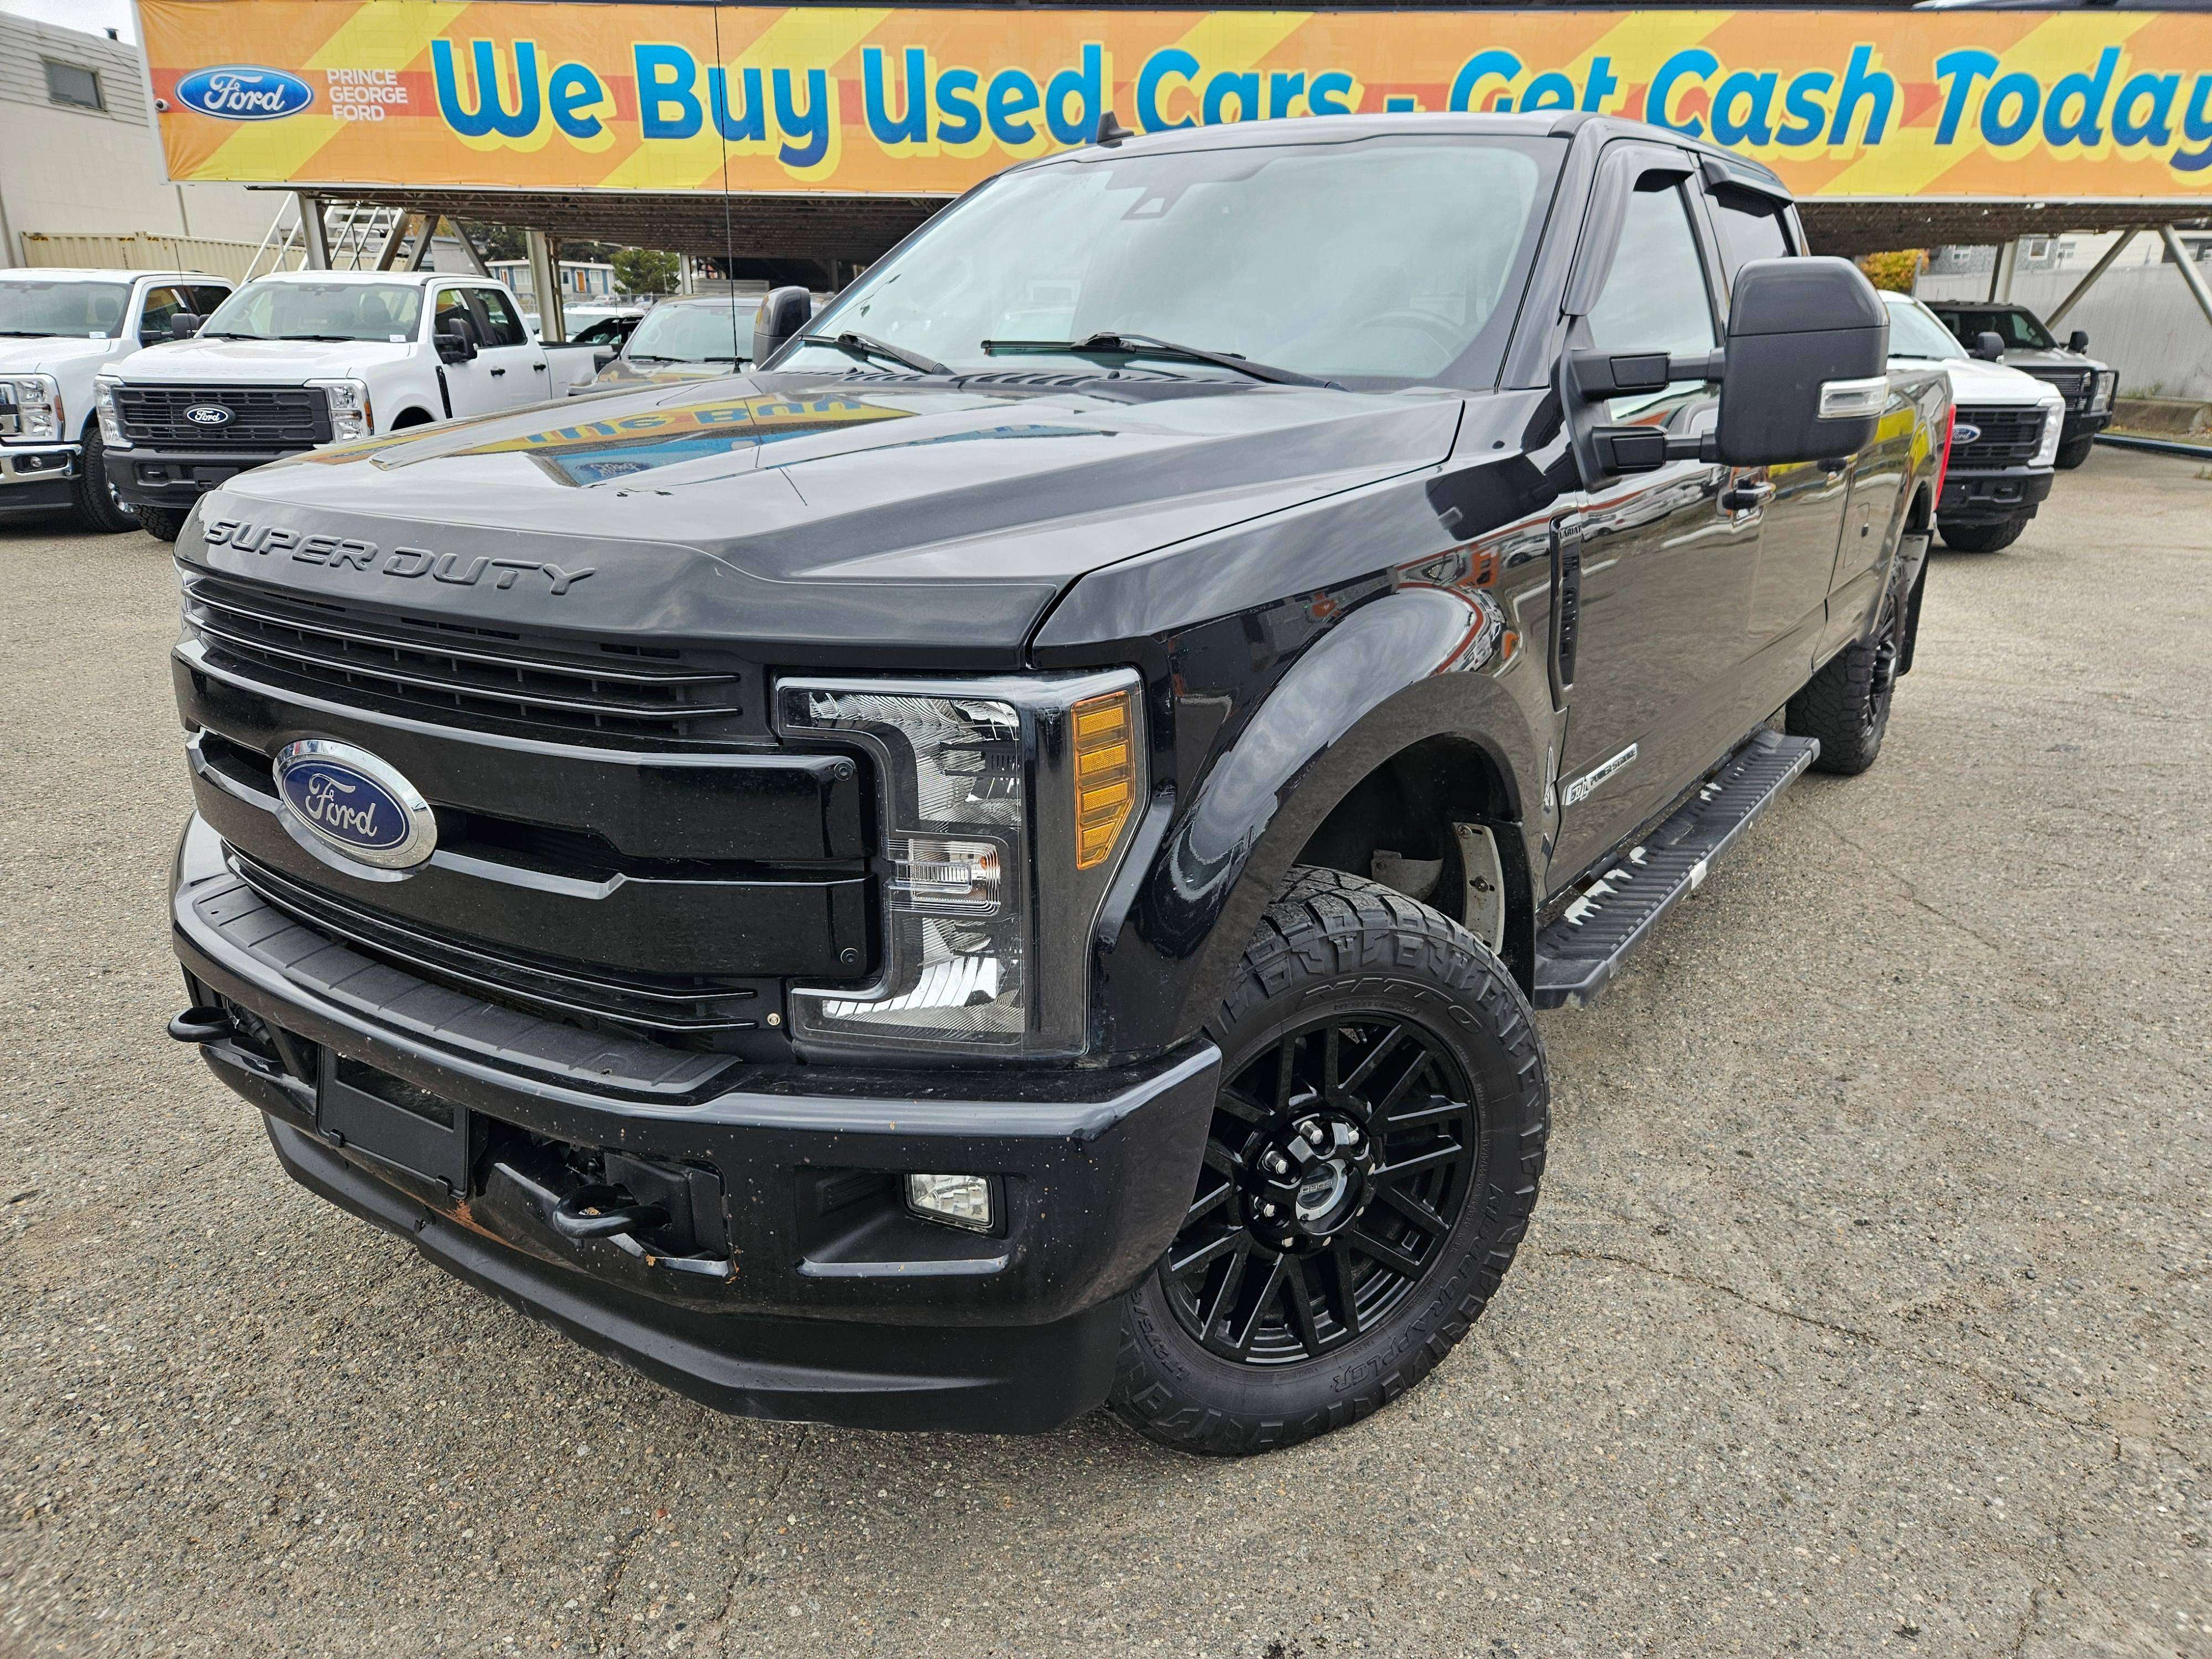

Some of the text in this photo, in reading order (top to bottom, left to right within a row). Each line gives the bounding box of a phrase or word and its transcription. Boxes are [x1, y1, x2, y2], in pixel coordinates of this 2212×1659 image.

[327, 69, 398, 85] PRINCE
[204, 72, 285, 112] Ford
[329, 86, 409, 104] GEORGE
[332, 104, 385, 122] FORD
[431, 40, 603, 138] We
[634, 44, 830, 168] Buy
[863, 43, 1102, 145] Used
[1137, 49, 1354, 134] Cars
[1647, 45, 1895, 146] Cash
[1935, 46, 2212, 172] Today
[195, 409, 221, 421] Ford
[1558, 525, 1582, 539] LARIAT
[204, 518, 597, 596] SUPER DUTY
[305, 773, 377, 837] Ford
